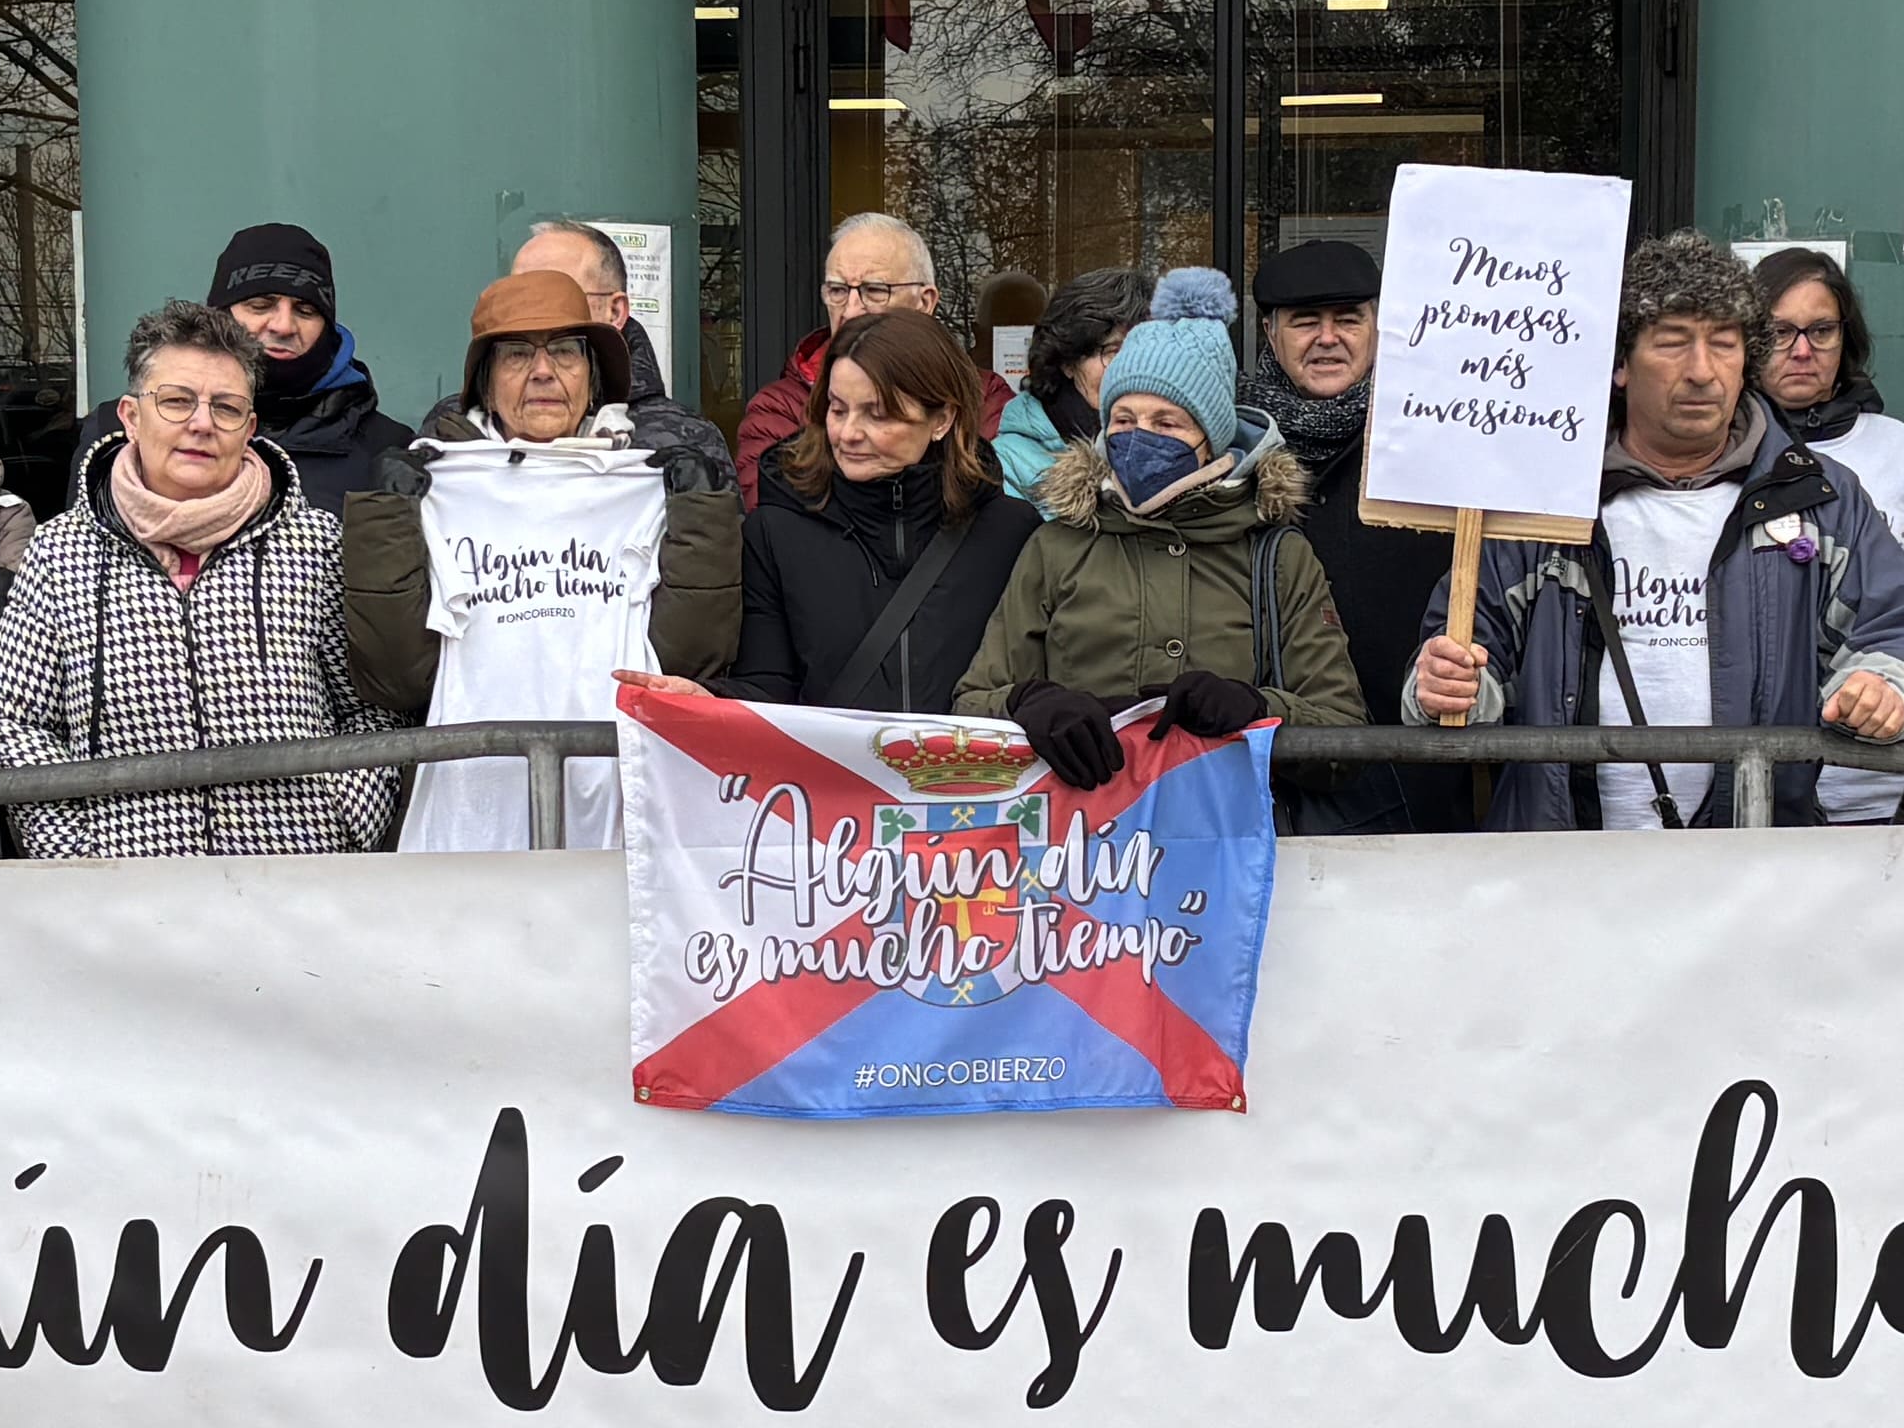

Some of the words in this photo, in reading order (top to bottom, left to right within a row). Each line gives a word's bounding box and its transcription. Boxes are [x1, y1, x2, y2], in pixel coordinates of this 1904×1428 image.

[1448, 236, 1571, 296] Menos
[1409, 299, 1581, 347] promesas,
[1460, 347, 1533, 390] más
[1402, 392, 1585, 442] inversiones
[561, 537, 610, 573] día
[465, 569, 549, 609] mucho
[497, 607, 576, 624] #ONCOBIERZO
[1648, 637, 1708, 648] #ONCOB
[1036, 809, 1166, 909] día
[684, 929, 749, 1002] es
[760, 892, 1016, 987] mucho
[854, 1055, 1066, 1090] #ONCOBIERZO
[388, 1106, 865, 1413] día
[927, 1195, 1121, 1410] es
